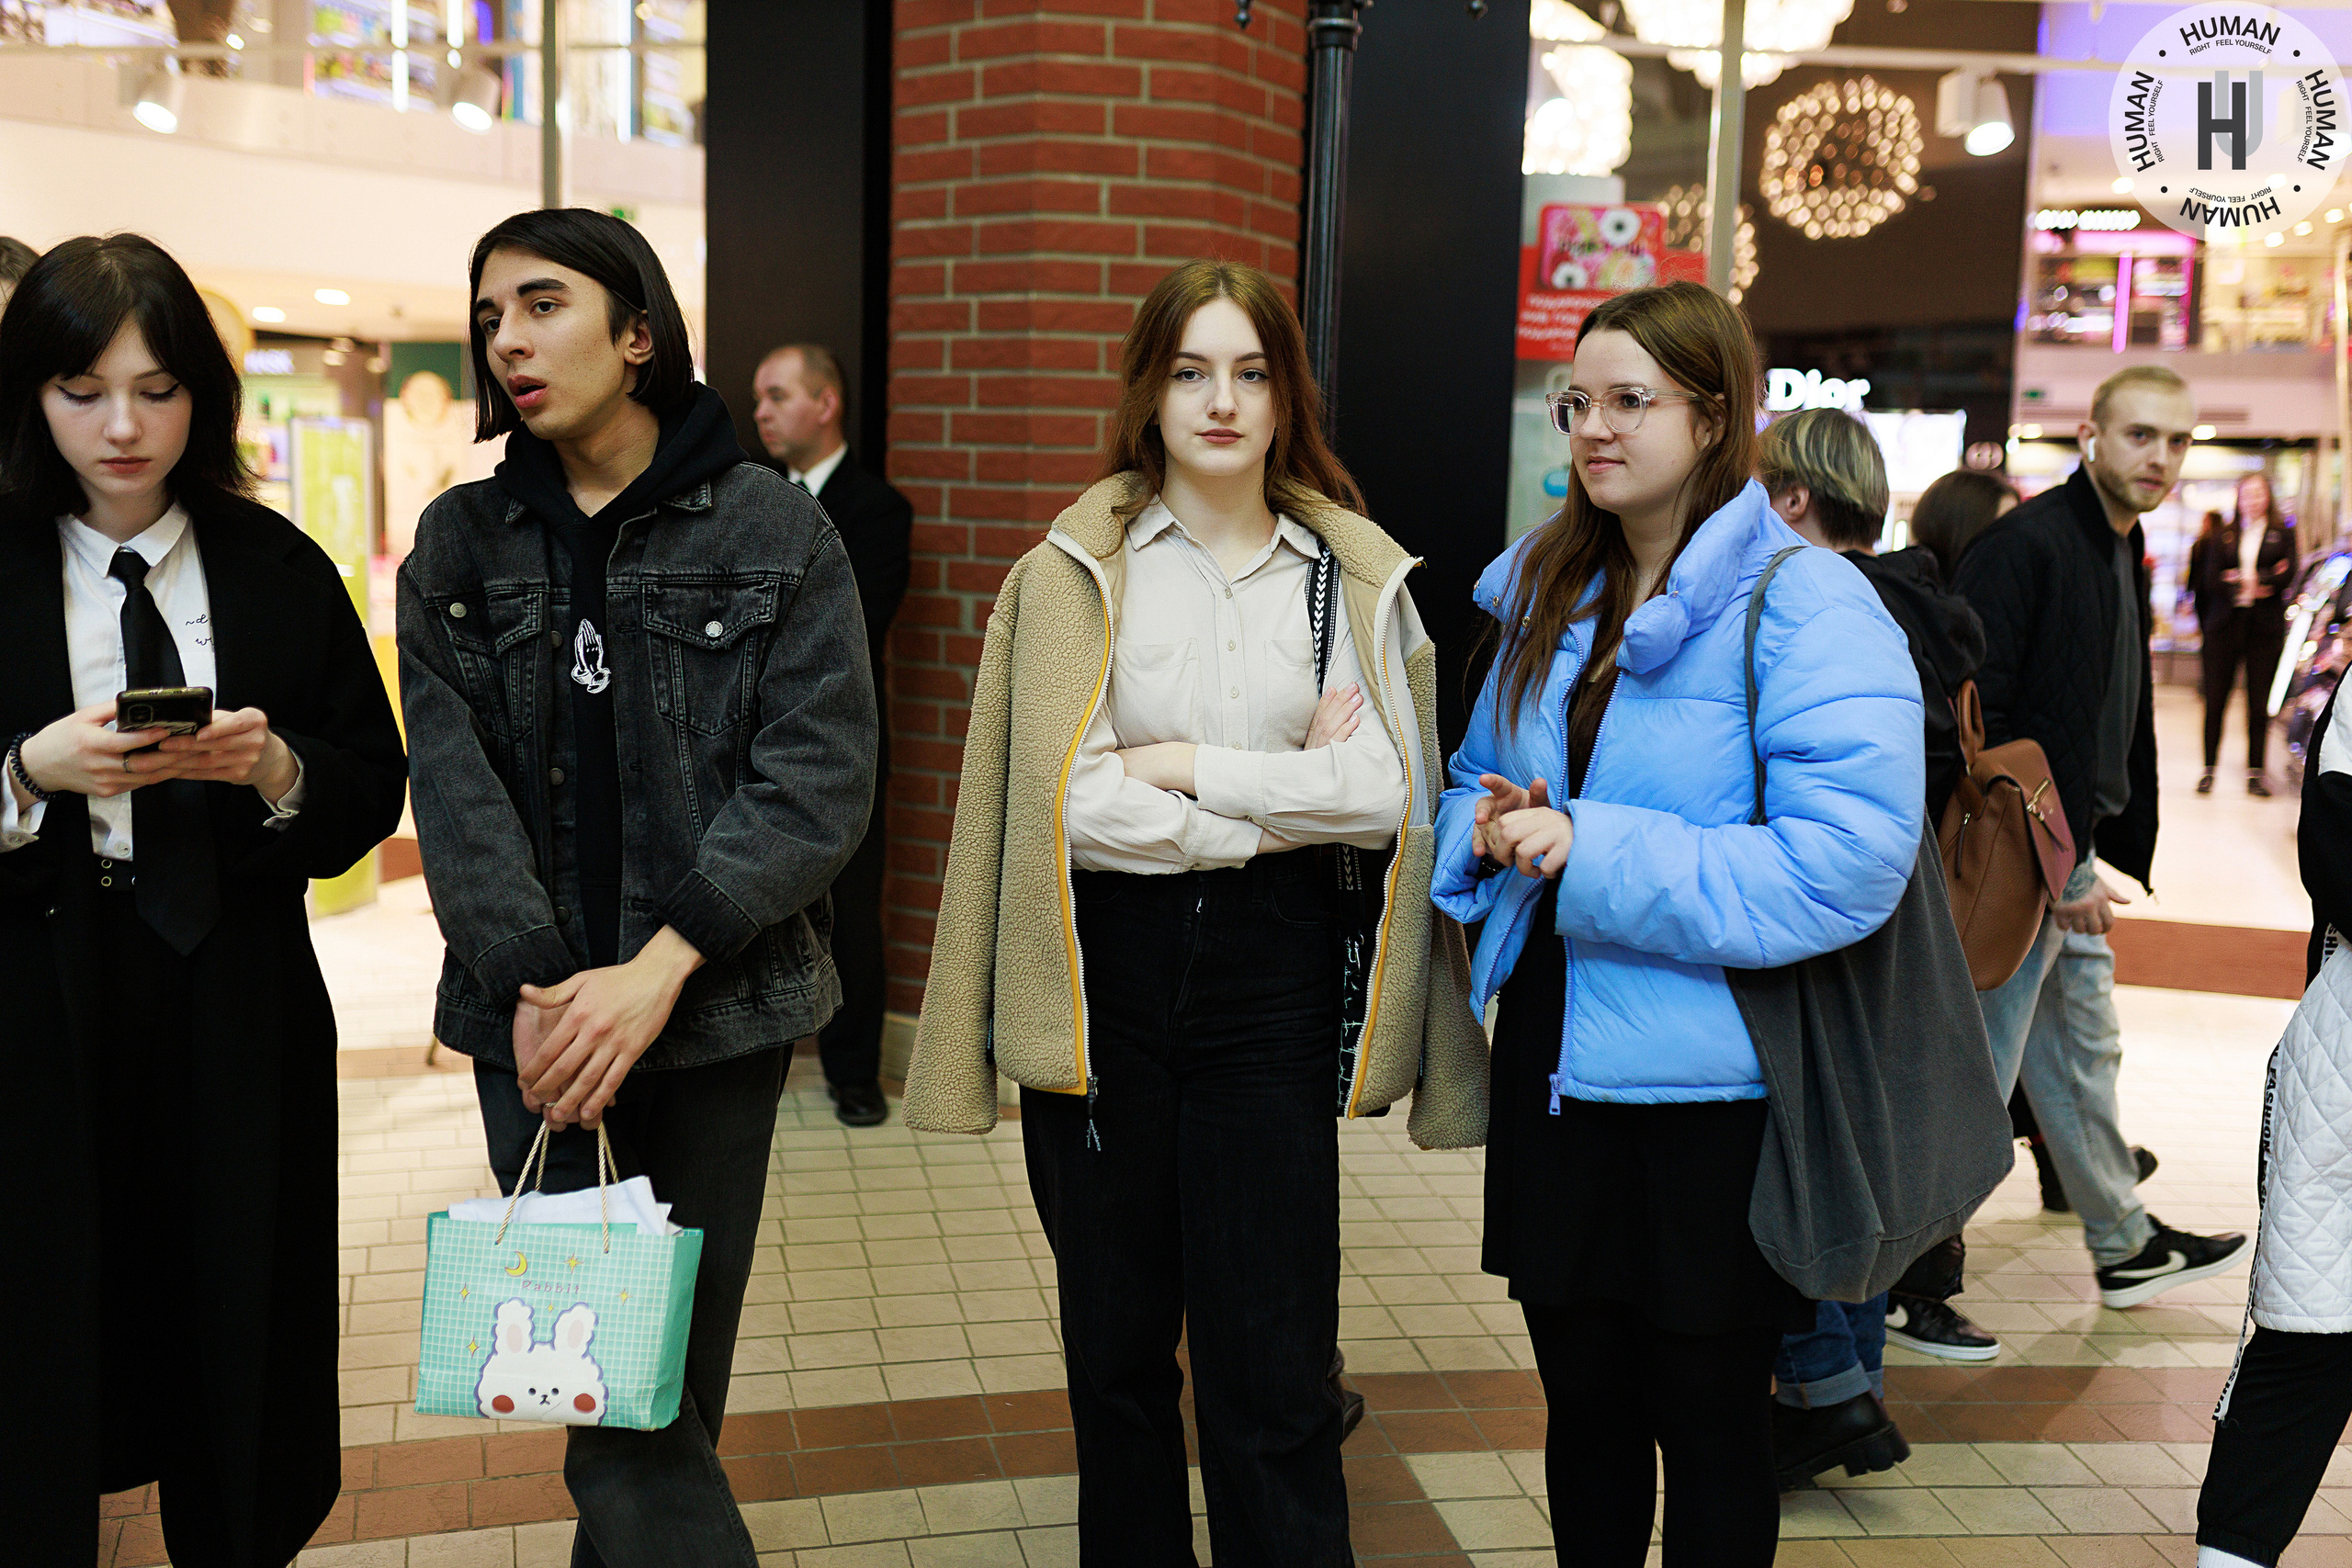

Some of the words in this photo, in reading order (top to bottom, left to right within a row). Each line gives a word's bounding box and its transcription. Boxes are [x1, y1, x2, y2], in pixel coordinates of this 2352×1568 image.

[1765, 367, 1871, 412] Dior
[2264, 1067, 2277, 1155] FASHION
[522, 1280, 580, 1294] Rabbit
